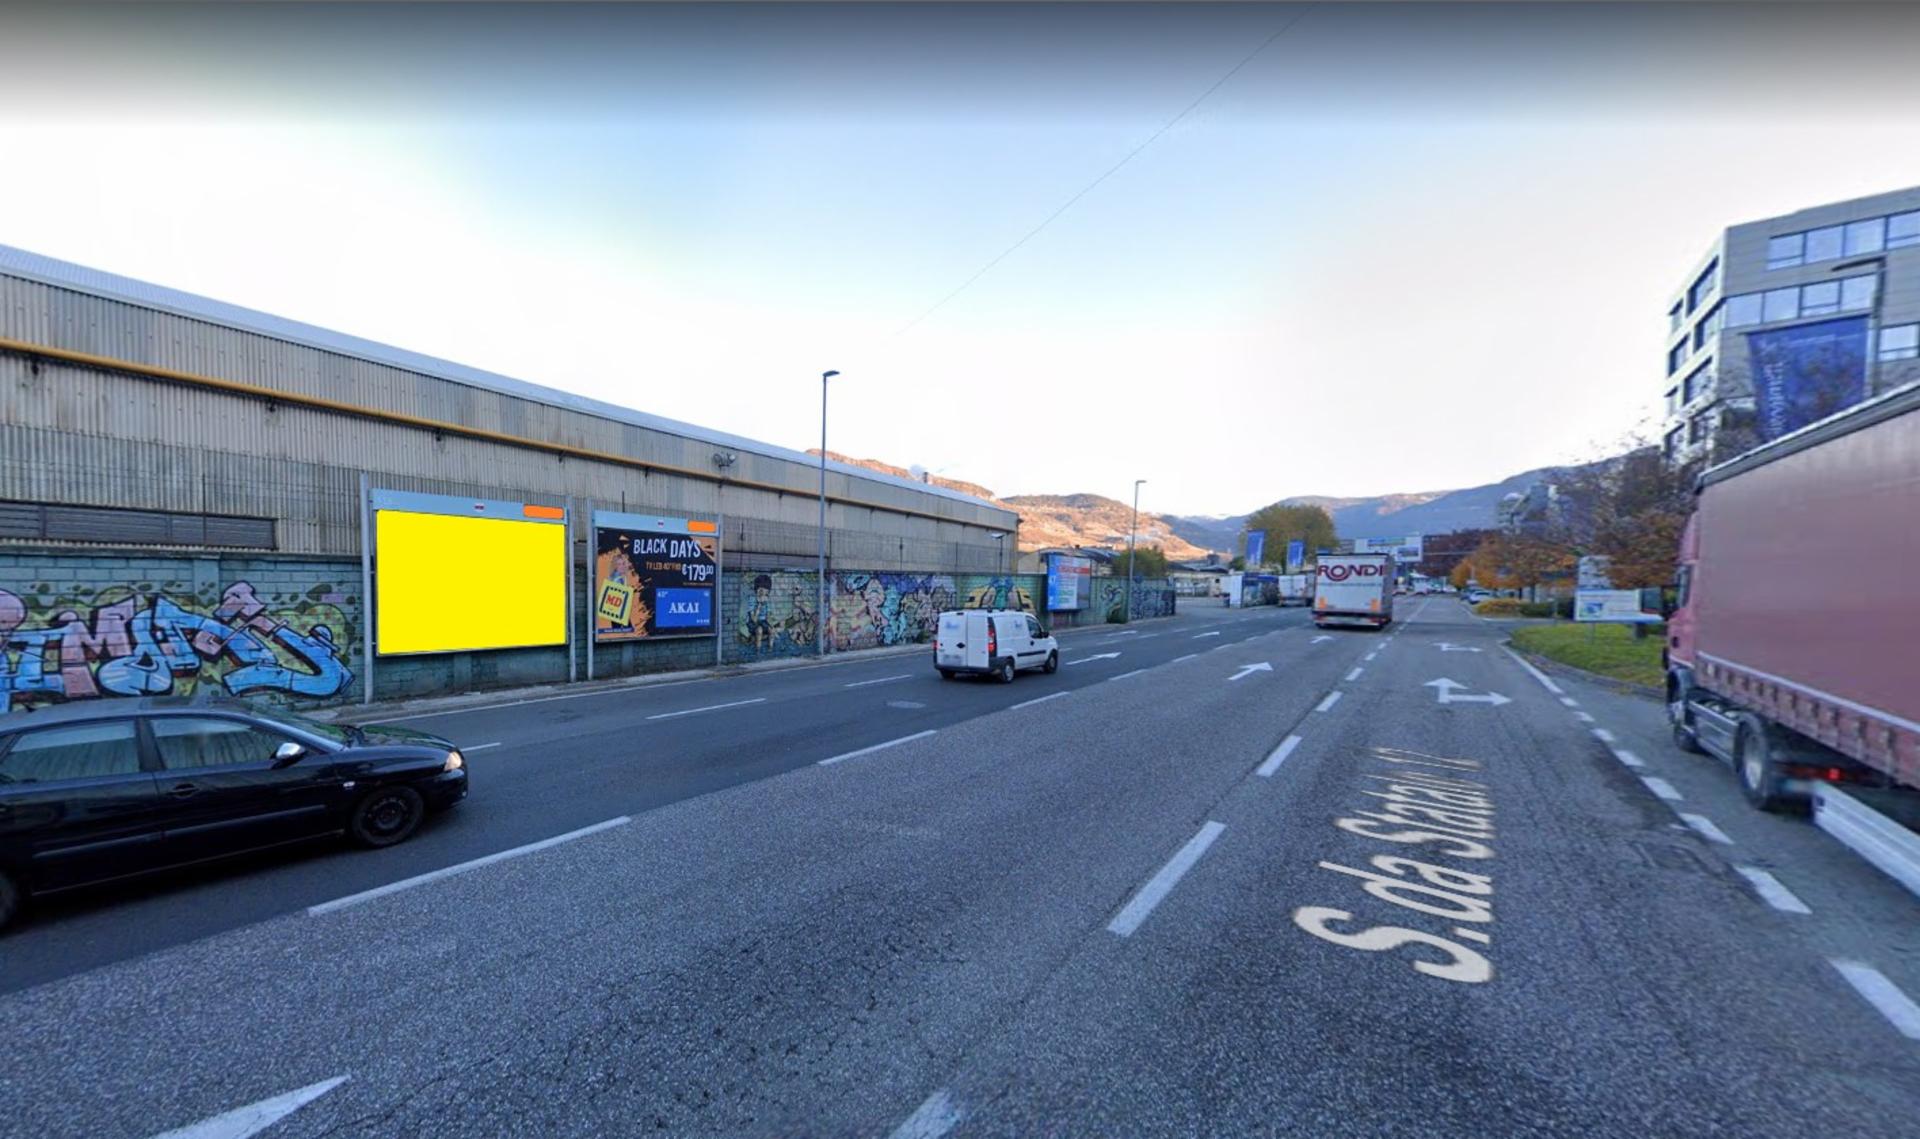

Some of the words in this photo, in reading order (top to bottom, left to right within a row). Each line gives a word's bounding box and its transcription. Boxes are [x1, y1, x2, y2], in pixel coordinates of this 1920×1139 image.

[633, 539, 667, 554] BLACK
[670, 540, 701, 558] DAYS
[1317, 565, 1384, 582] RONDI
[605, 594, 622, 607] MD
[669, 602, 699, 614] AKAI
